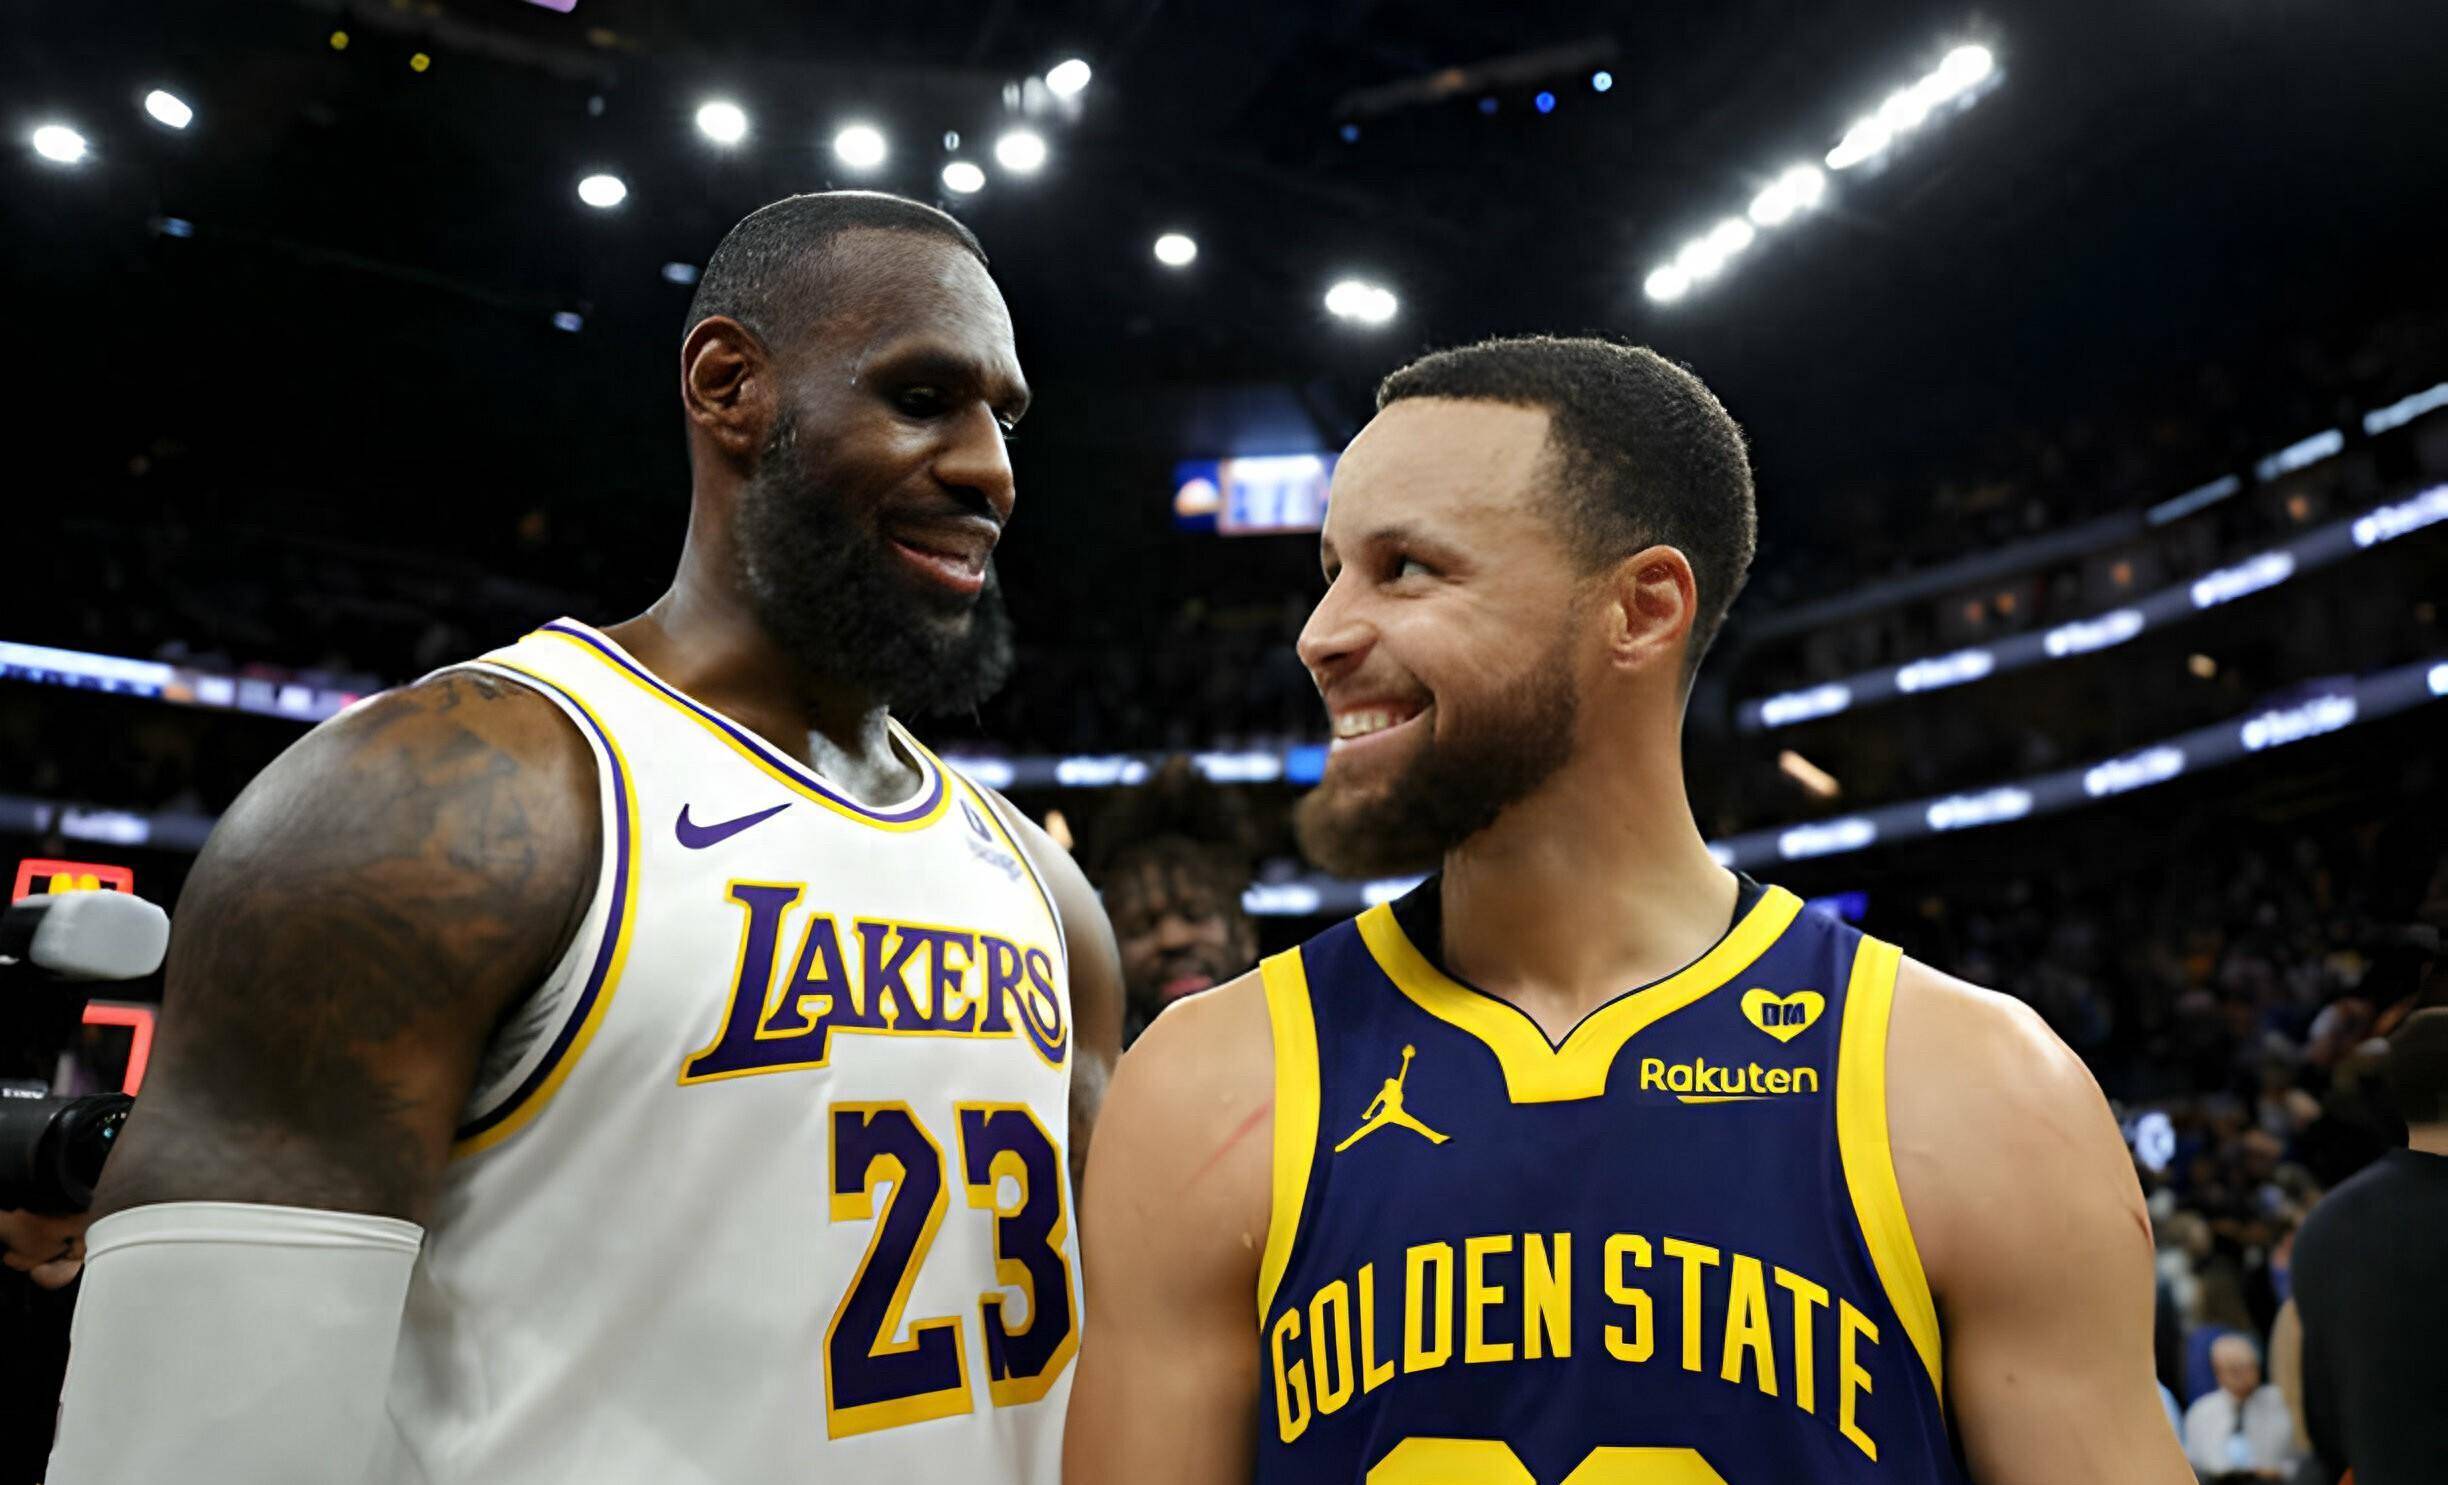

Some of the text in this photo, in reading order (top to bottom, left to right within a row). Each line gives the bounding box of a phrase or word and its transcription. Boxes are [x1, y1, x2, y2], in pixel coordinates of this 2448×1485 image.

[677, 878, 1067, 1086] LAKERS
[1640, 1057, 1818, 1094] Rakuten
[823, 1101, 1081, 1440] 23
[1271, 1232, 1880, 1463] GOLDEN STATE
